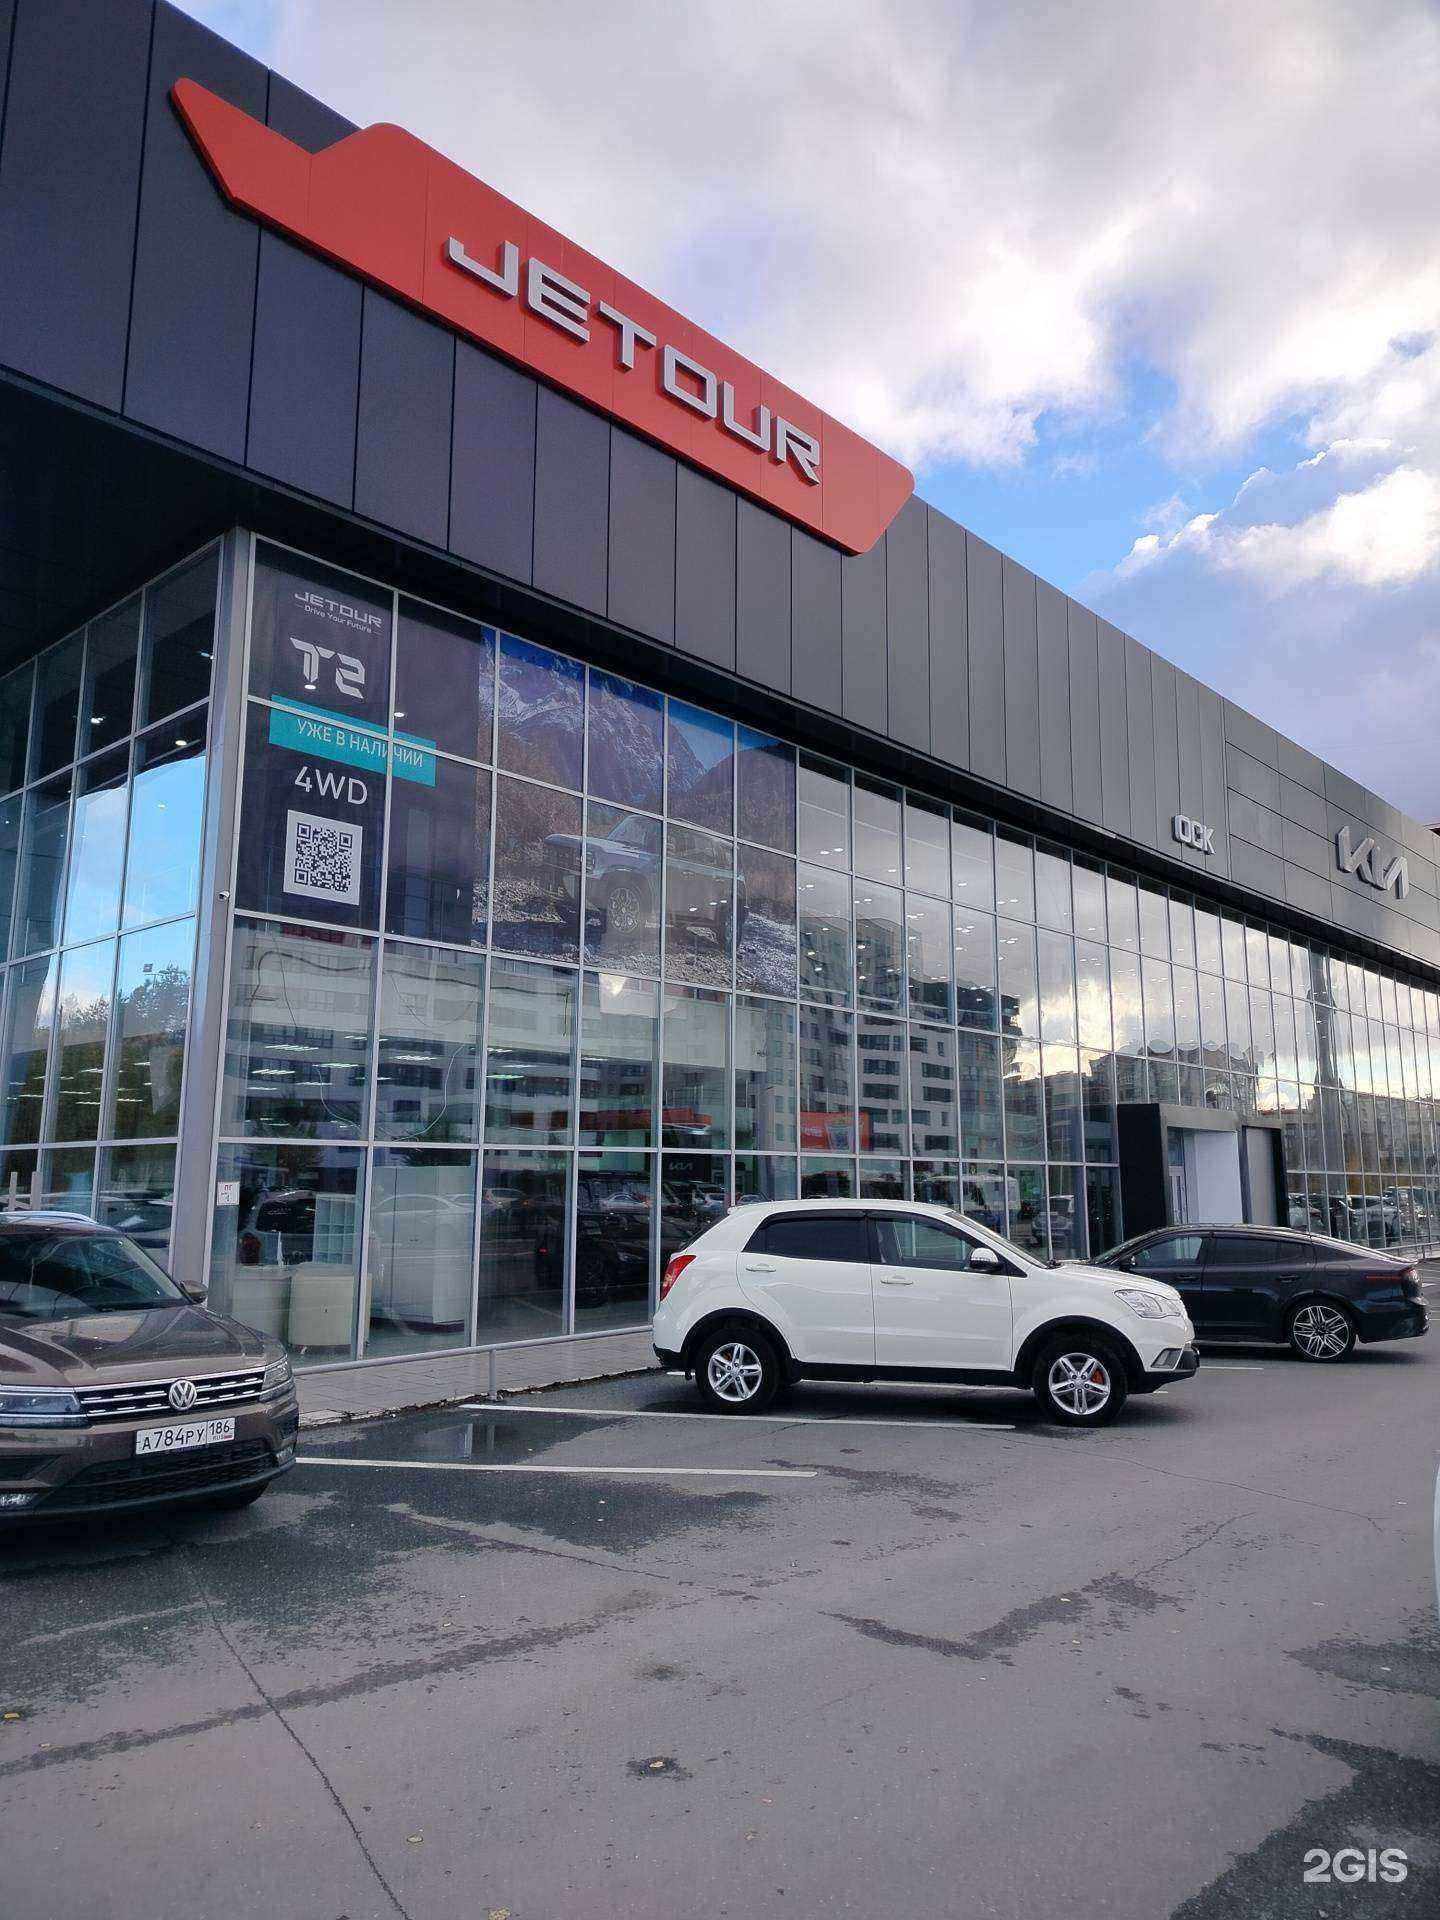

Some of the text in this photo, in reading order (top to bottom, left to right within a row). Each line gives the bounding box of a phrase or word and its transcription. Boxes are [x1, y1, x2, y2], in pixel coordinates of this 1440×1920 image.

[447, 235, 820, 486] JETOUR
[294, 592, 382, 628] JETOUR
[304, 604, 372, 634] Drive Your Future
[290, 637, 366, 699] T2
[297, 718, 333, 742] УЖЕ
[335, 730, 346, 746] В
[294, 766, 368, 805] 4WD
[209, 1420, 230, 1436] 186
